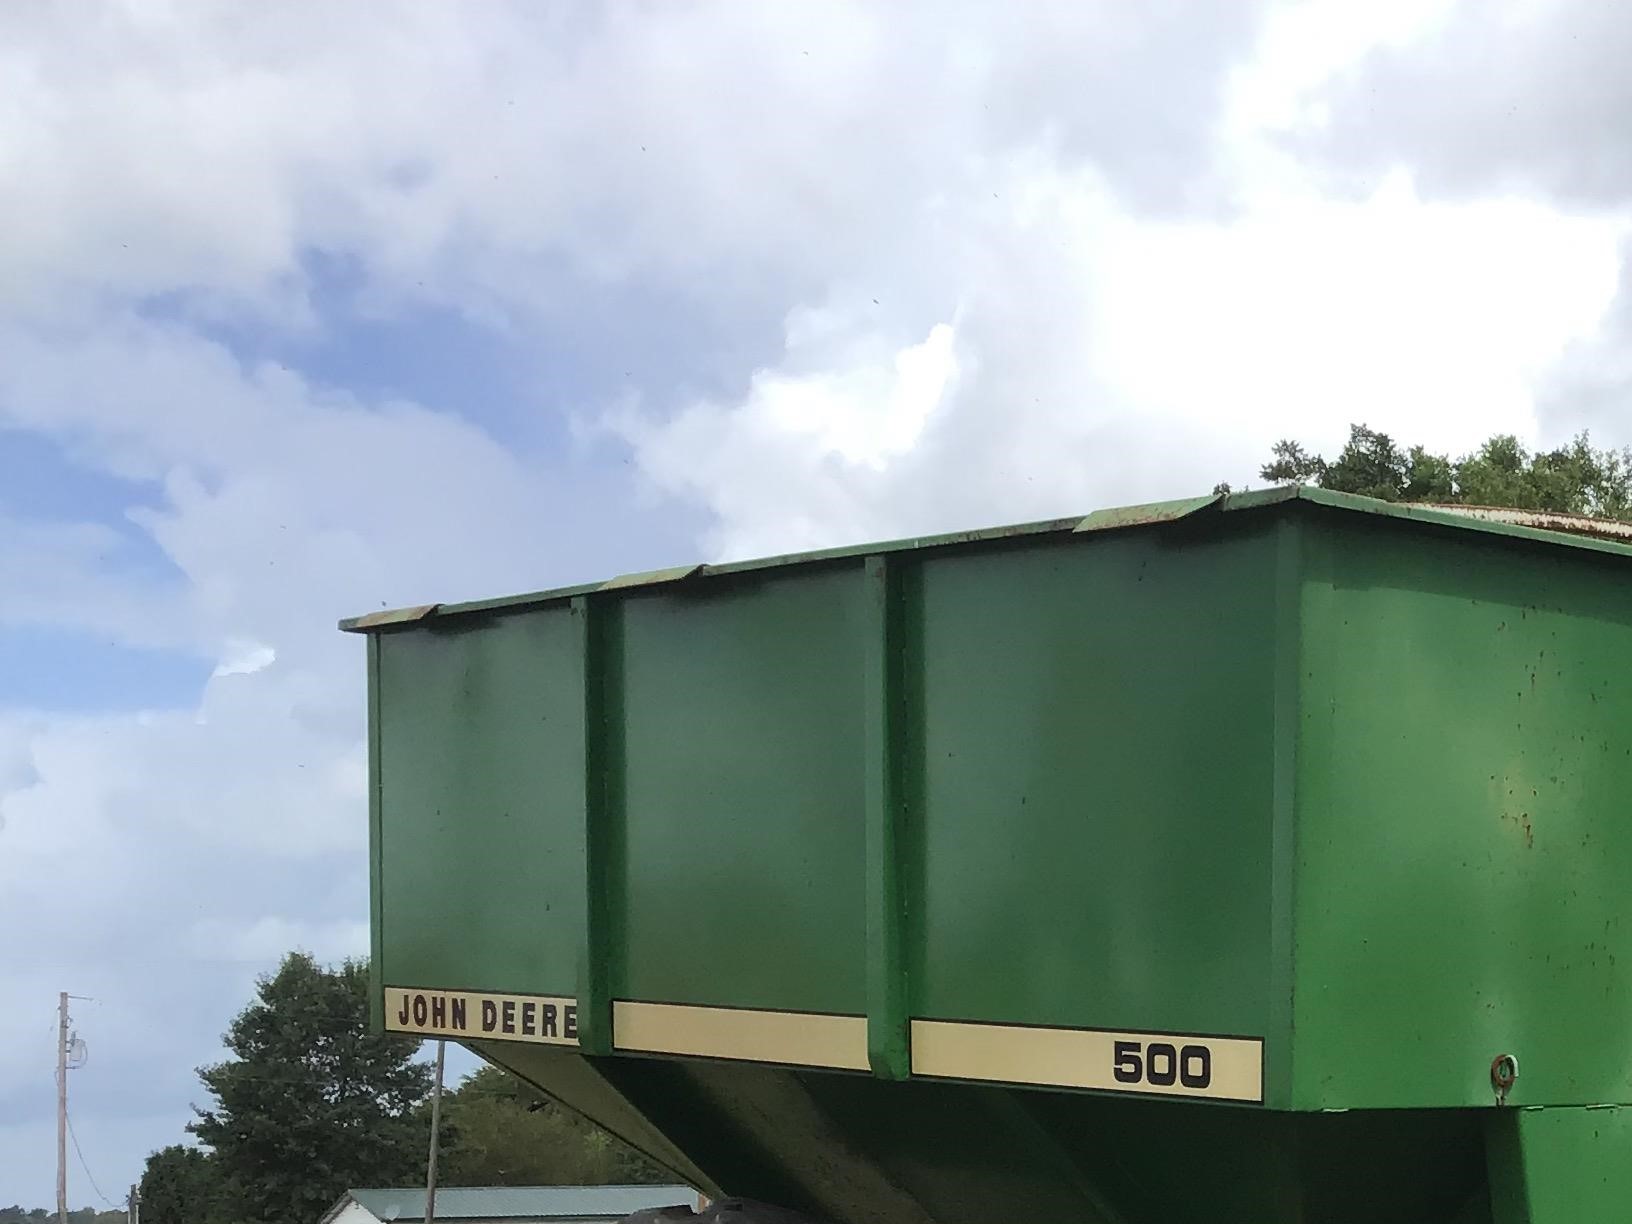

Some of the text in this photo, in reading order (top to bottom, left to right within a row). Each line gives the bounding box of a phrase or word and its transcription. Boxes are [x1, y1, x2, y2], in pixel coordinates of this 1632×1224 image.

[398, 994, 577, 1039] JOHN DEERE
[1113, 1040, 1211, 1089] 500
